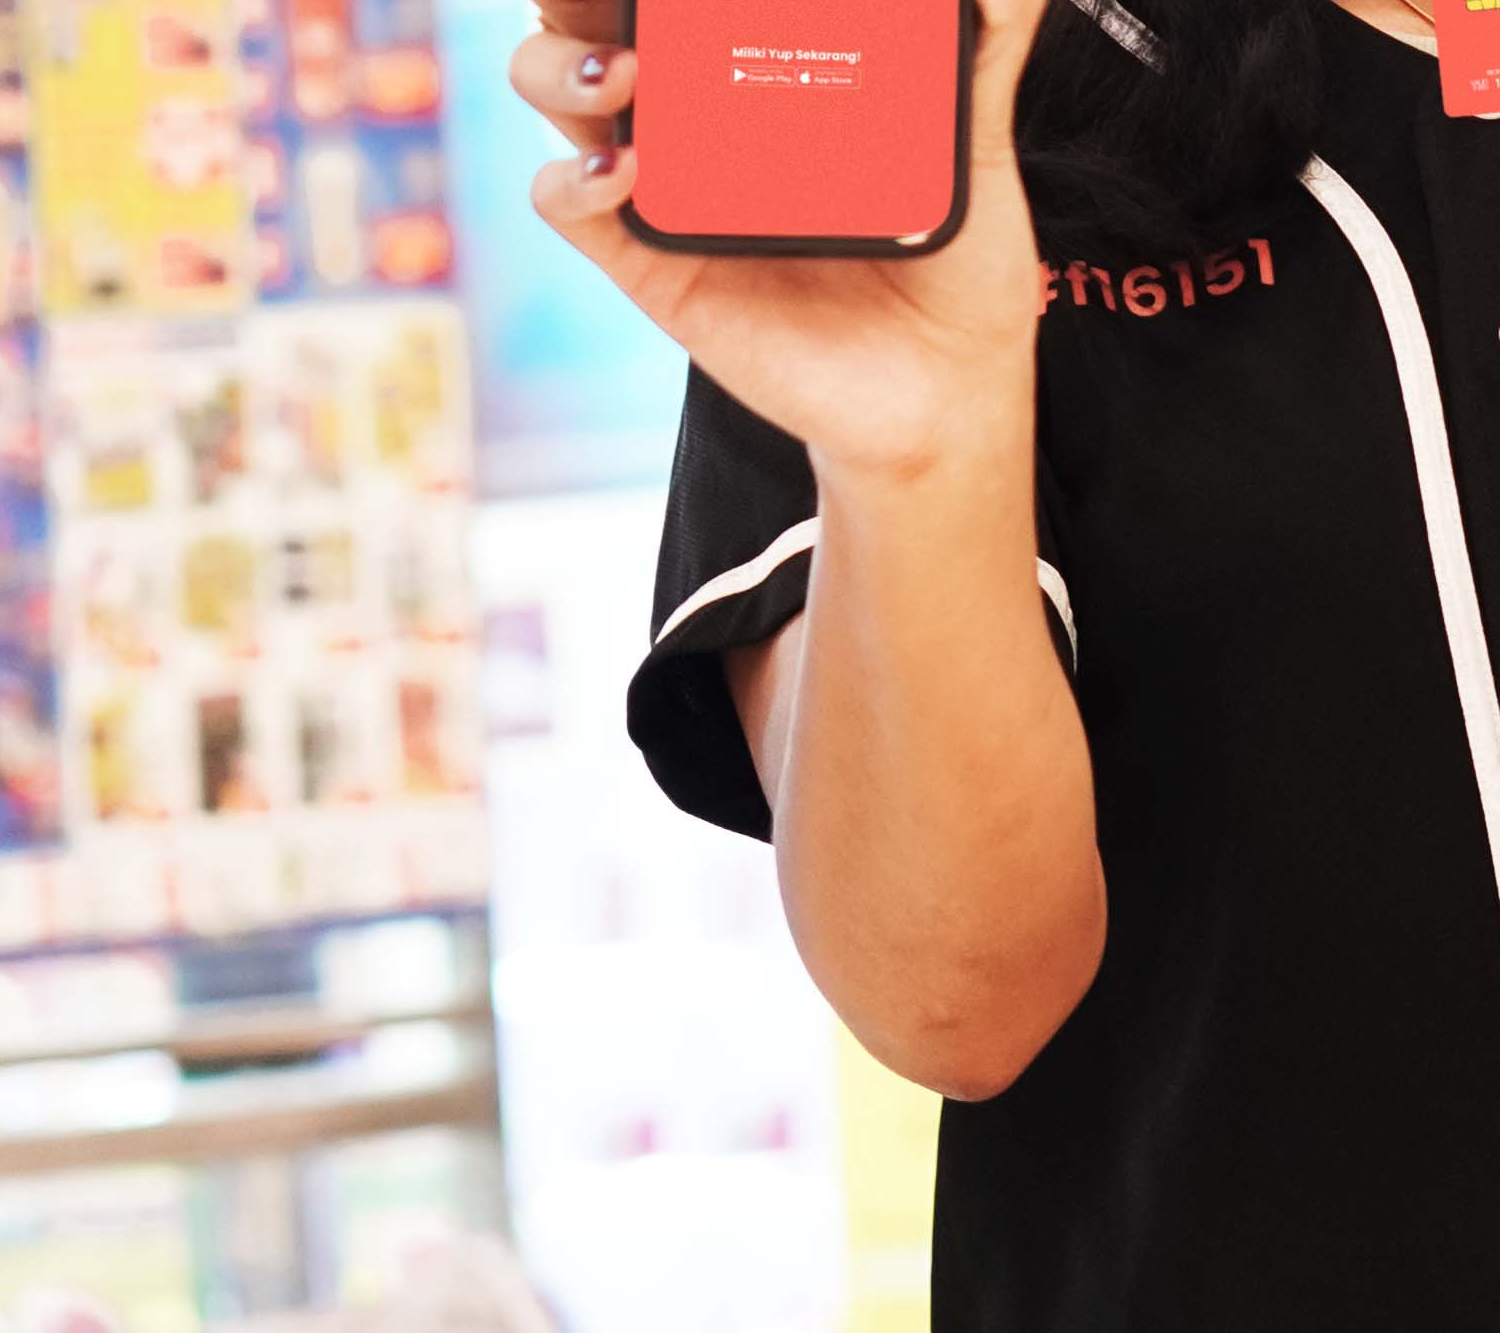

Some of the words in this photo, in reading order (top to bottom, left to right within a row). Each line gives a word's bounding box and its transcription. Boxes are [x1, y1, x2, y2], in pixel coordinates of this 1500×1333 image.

[732, 47, 766, 59] Miliki
[768, 48, 793, 63] Yup
[795, 49, 861, 65] Sekarang!
